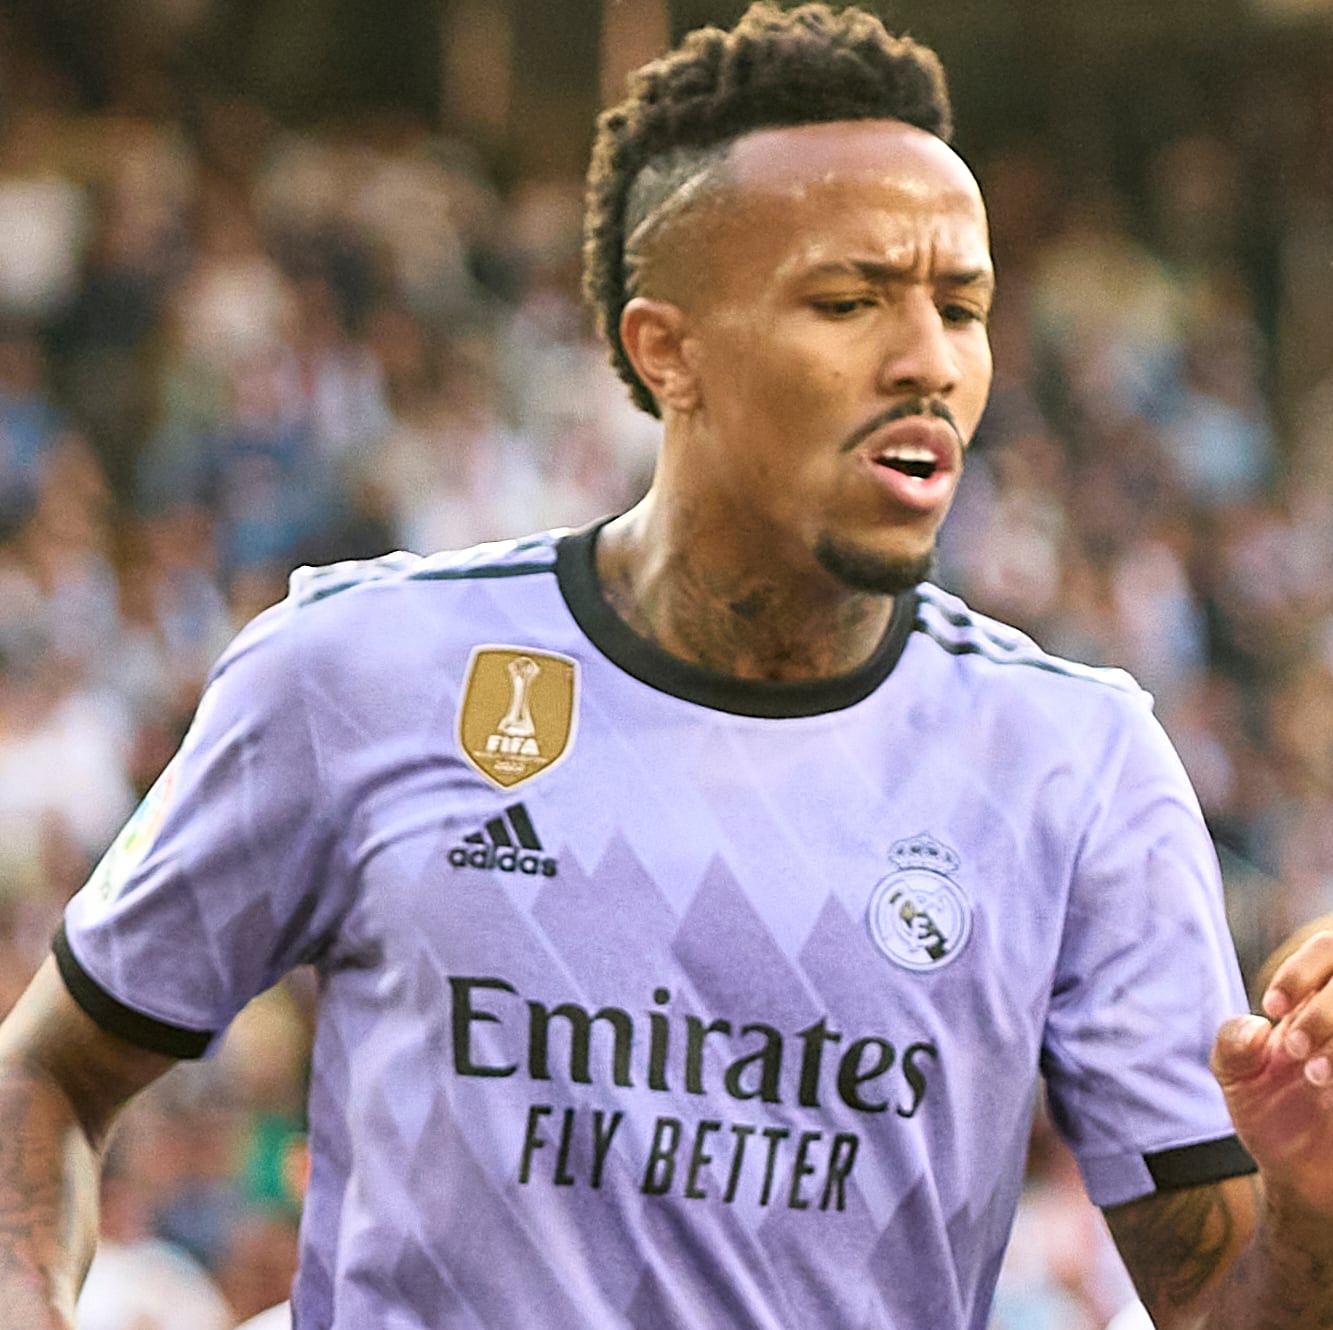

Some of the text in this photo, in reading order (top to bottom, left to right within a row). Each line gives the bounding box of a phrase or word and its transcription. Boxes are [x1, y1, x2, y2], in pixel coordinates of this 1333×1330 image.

[448, 842, 558, 878] adidas
[449, 975, 938, 1118] Emirates
[518, 1104, 860, 1212] FLY BETTER
